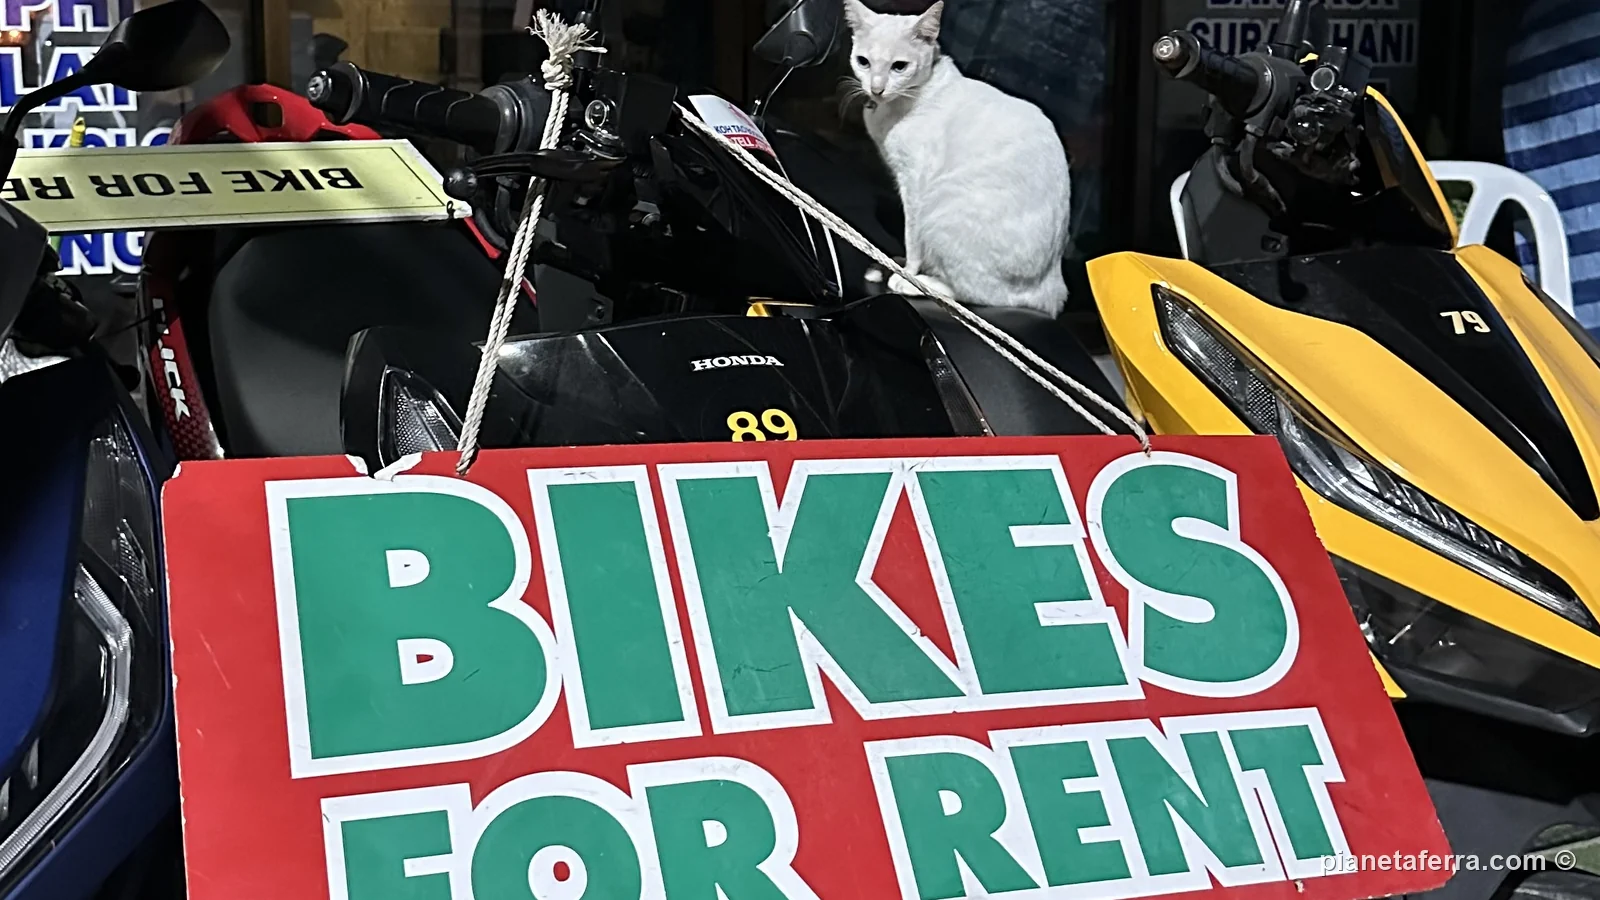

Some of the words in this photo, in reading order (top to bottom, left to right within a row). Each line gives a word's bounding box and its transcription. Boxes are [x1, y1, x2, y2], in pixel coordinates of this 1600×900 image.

[88, 172, 213, 197] FOR
[221, 168, 364, 193] BIKE
[1440, 310, 1491, 335] 79
[690, 355, 784, 371] HONDA
[727, 408, 797, 442] 89
[265, 451, 1299, 779] BIKES
[321, 756, 823, 900] FOR
[864, 707, 1357, 900] RENT
